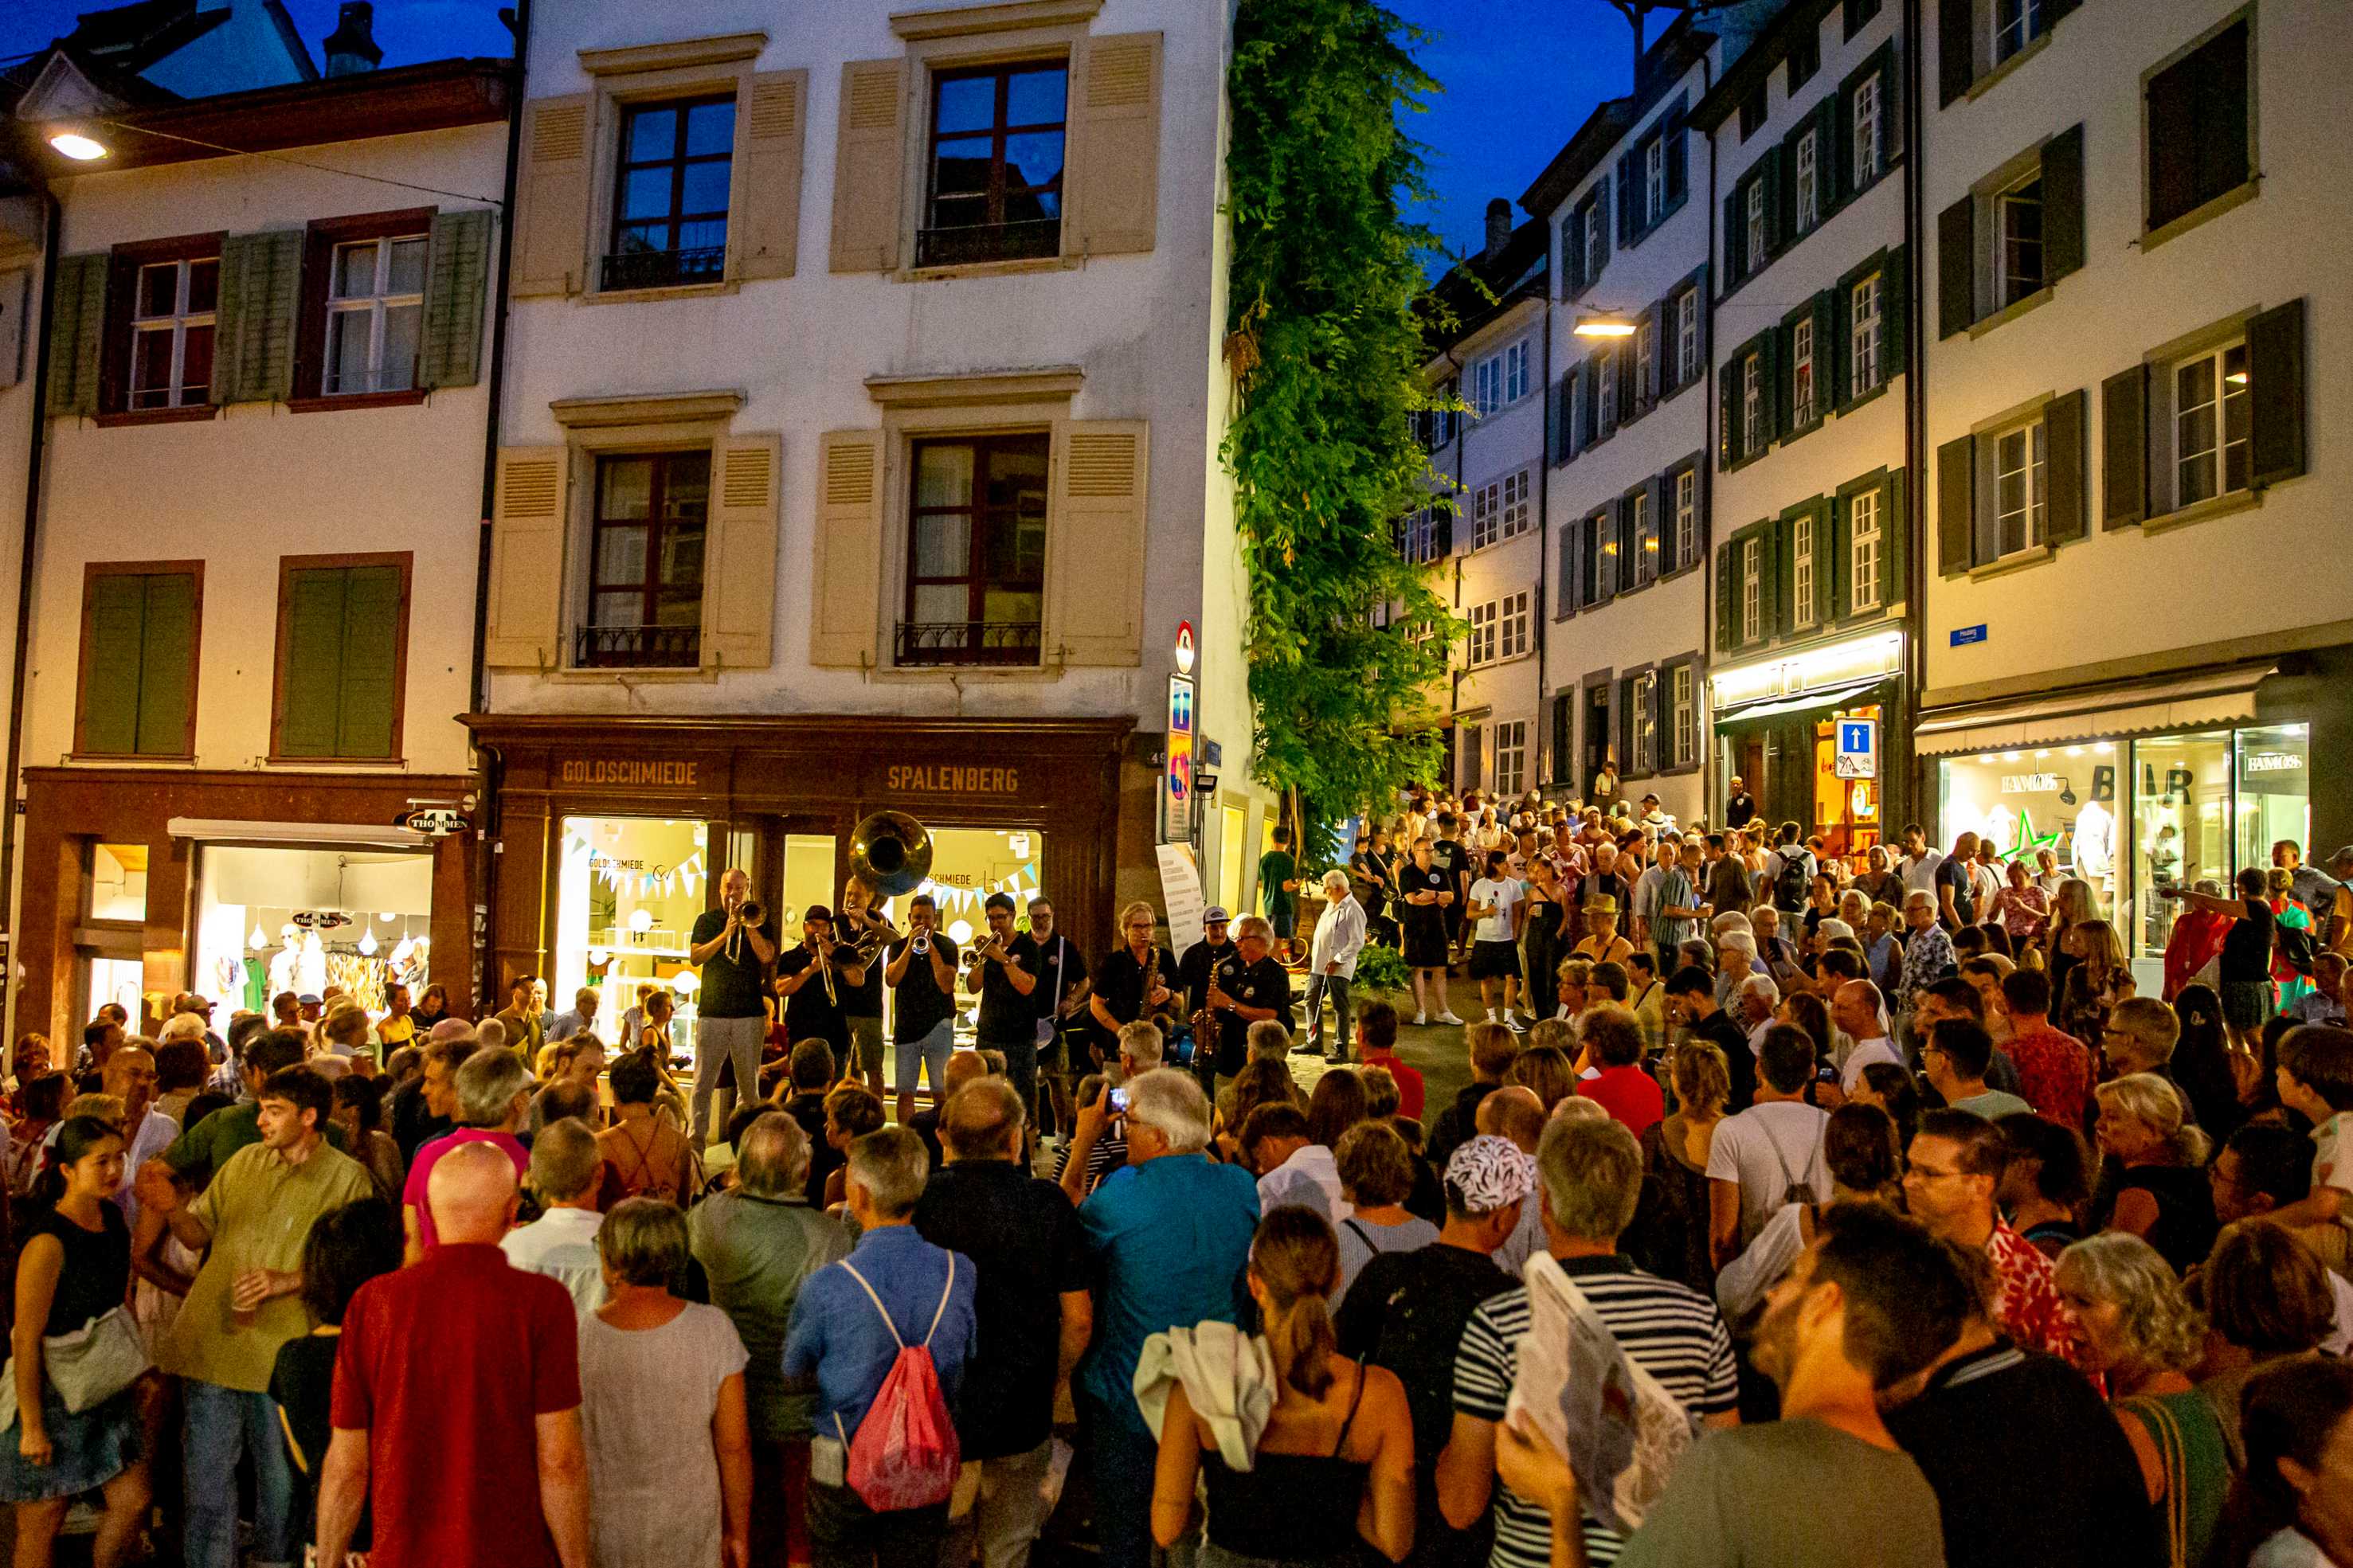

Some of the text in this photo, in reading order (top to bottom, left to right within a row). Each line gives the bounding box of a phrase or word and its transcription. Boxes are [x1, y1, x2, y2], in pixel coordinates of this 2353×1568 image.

[562, 761, 698, 785] GOLDSCHMIEDE
[887, 765, 1019, 792] SPALENBERG
[411, 819, 468, 828] THOMMEN
[589, 858, 644, 870] GOLDSHMIEDE
